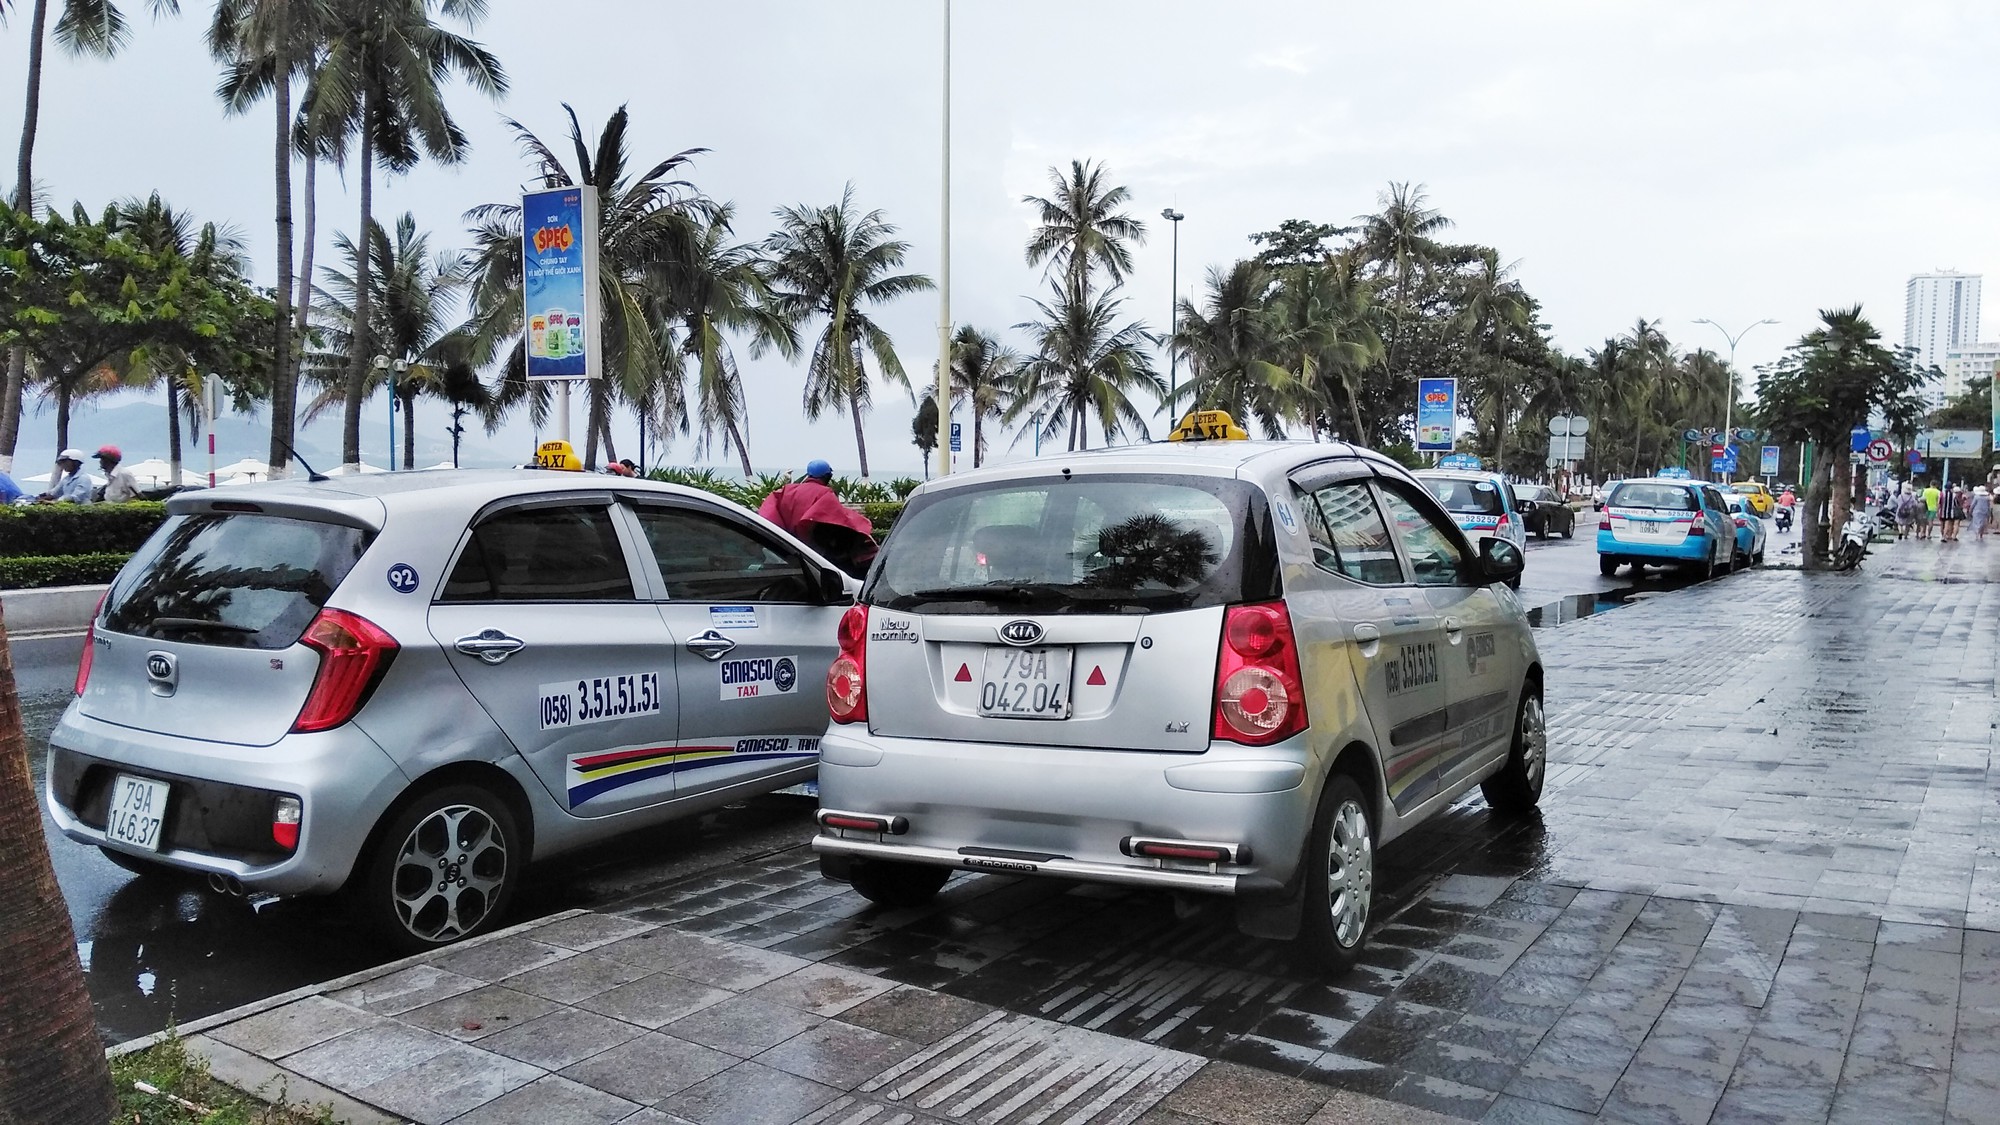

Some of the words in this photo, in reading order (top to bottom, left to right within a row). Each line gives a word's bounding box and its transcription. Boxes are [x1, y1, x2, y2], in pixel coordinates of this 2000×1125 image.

[538, 227, 568, 249] SPEC
[1428, 394, 1446, 402] SPEC
[953, 425, 959, 435] P
[391, 569, 416, 588] 92
[880, 617, 911, 630] New
[1008, 625, 1035, 638] KIA
[871, 630, 920, 644] morning
[150, 664, 167, 674] KIA
[721, 658, 773, 684] EMASCO
[1003, 649, 1047, 680] 79A
[737, 685, 759, 697] TAXI
[982, 681, 1062, 713] 042.04
[540, 694, 572, 729] (058)
[578, 673, 659, 720] 3.51.51.51
[124, 782, 153, 813] 79A
[110, 810, 160, 845] 146.37
